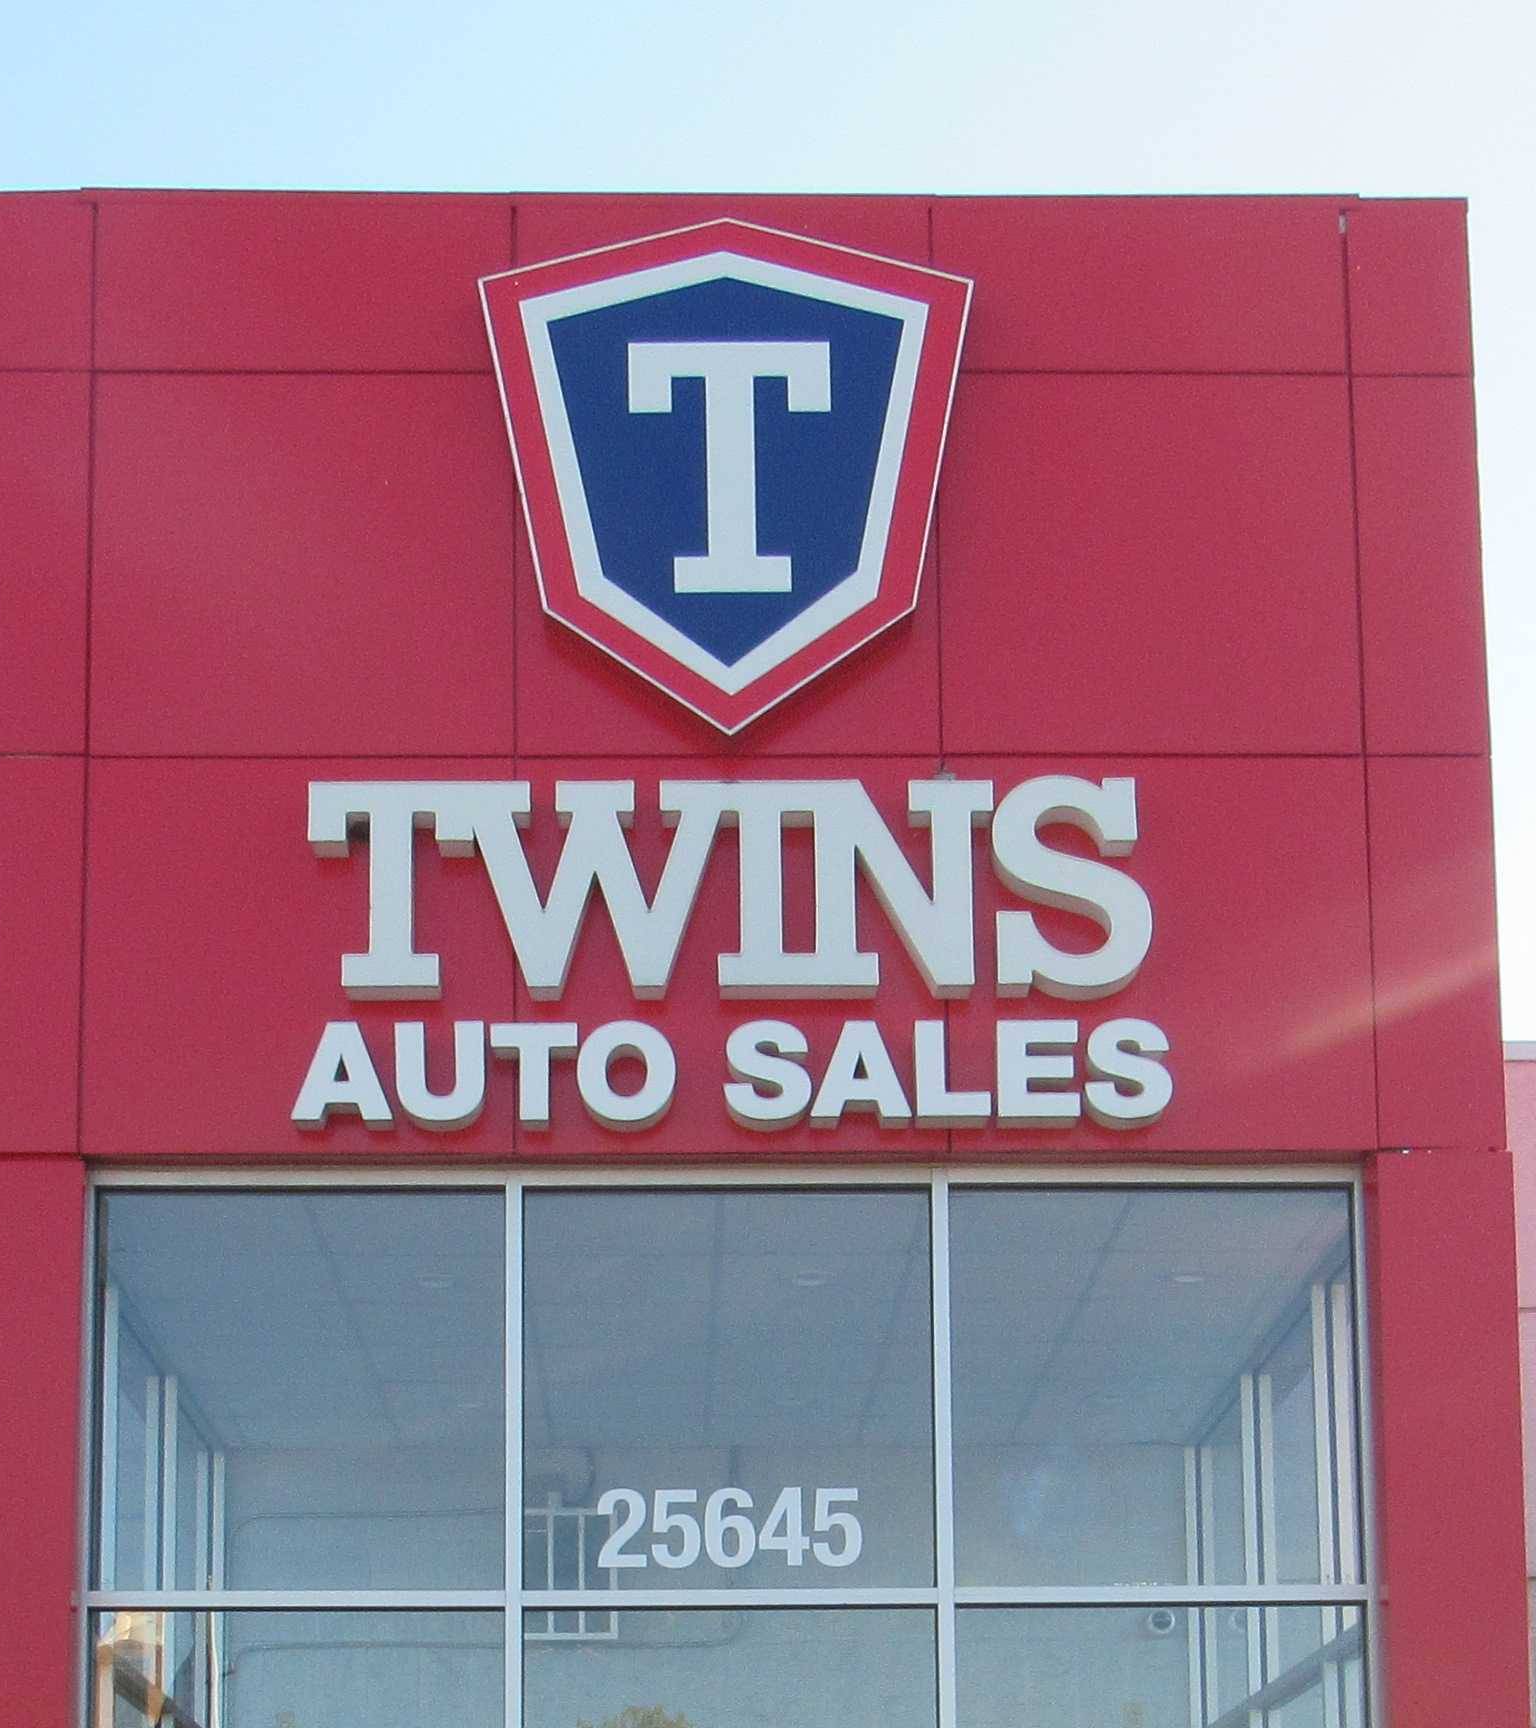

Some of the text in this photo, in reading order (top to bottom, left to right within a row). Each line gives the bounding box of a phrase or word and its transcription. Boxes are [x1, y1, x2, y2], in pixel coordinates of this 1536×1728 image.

[628, 341, 832, 593] T
[307, 774, 1154, 1000] TWINS
[290, 1017, 1173, 1131] AUTO SALES
[596, 1486, 863, 1569] 25645
